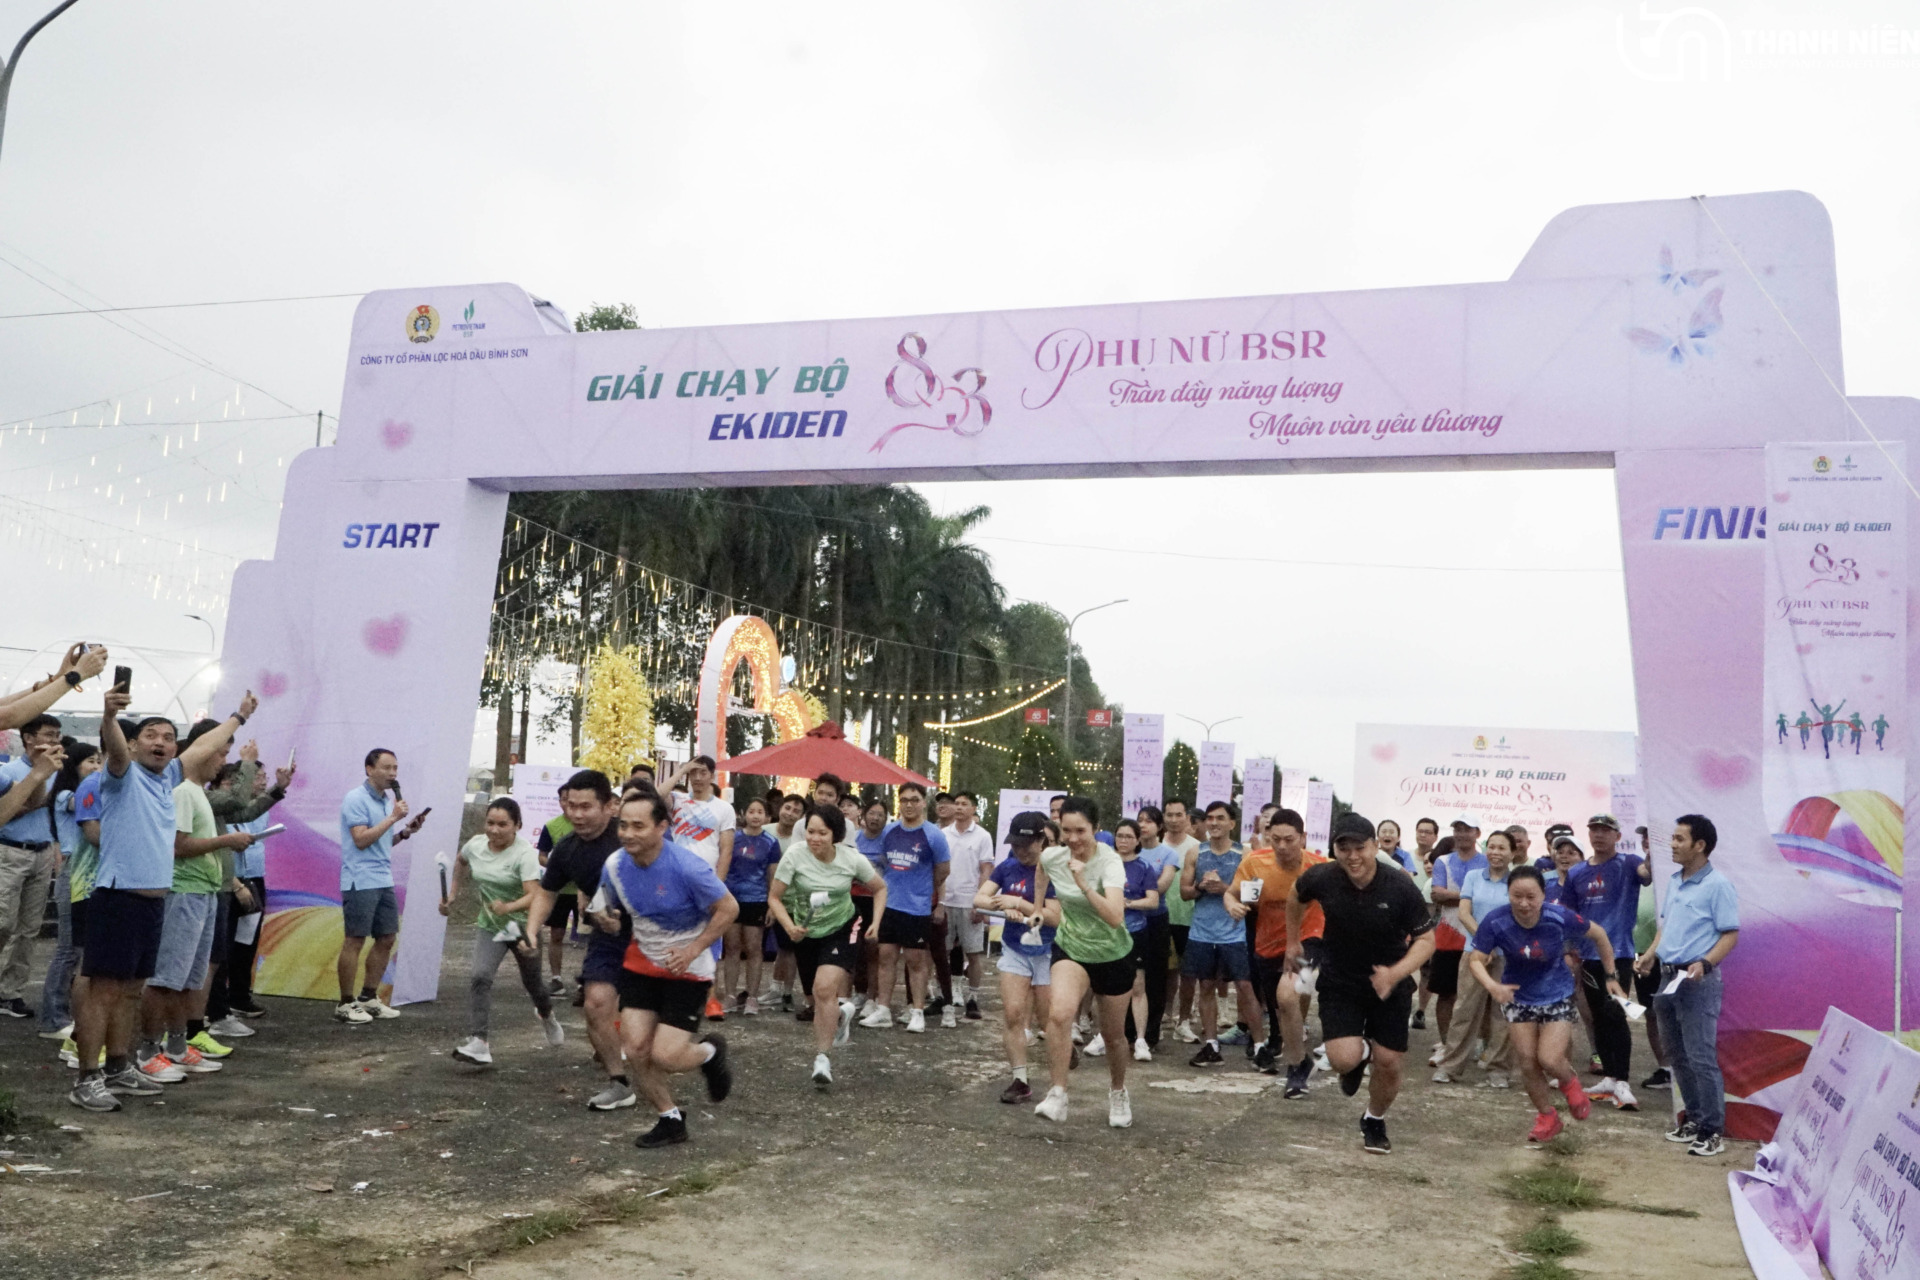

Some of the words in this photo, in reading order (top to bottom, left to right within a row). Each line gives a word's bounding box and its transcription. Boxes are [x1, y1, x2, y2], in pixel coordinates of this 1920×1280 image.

[360, 353, 382, 365] CÔNG
[385, 354, 394, 364] TY
[396, 351, 407, 364] CỔ
[409, 349, 431, 363] PHẦN
[433, 352, 449, 364] LỌC
[451, 349, 467, 361] HOÁ
[469, 348, 486, 360] DẦU
[488, 347, 508, 360] BÌNH
[510, 347, 529, 358] SƠN
[1021, 328, 1156, 410] PHỤ
[1169, 330, 1229, 365] NỮ
[1240, 330, 1328, 362] BSR
[586, 366, 663, 402] GIẢI
[675, 367, 780, 403] CHẠY
[793, 358, 850, 399] BỘ
[1109, 378, 1166, 408] Tràn
[1170, 377, 1212, 408] đầy
[1218, 379, 1277, 404] năng
[1281, 377, 1344, 405] lượng
[708, 409, 849, 441] EKIDEN
[1249, 411, 1325, 444] Muôn
[1328, 414, 1372, 436] vàn
[1376, 414, 1417, 440] yêu
[1421, 408, 1504, 437] thương
[342, 522, 440, 549] START
[1803, 522, 1831, 534] CHẠY
[1835, 521, 1850, 533] BỘ
[1854, 522, 1892, 532] EKIDEN
[1843, 600, 1870, 610] BSR
[1424, 764, 1451, 777] GIẢI
[1455, 767, 1490, 780] CHẠY
[1495, 768, 1514, 781] BỘ
[1519, 771, 1567, 782] EKIDEN
[1478, 784, 1511, 797] BSR
